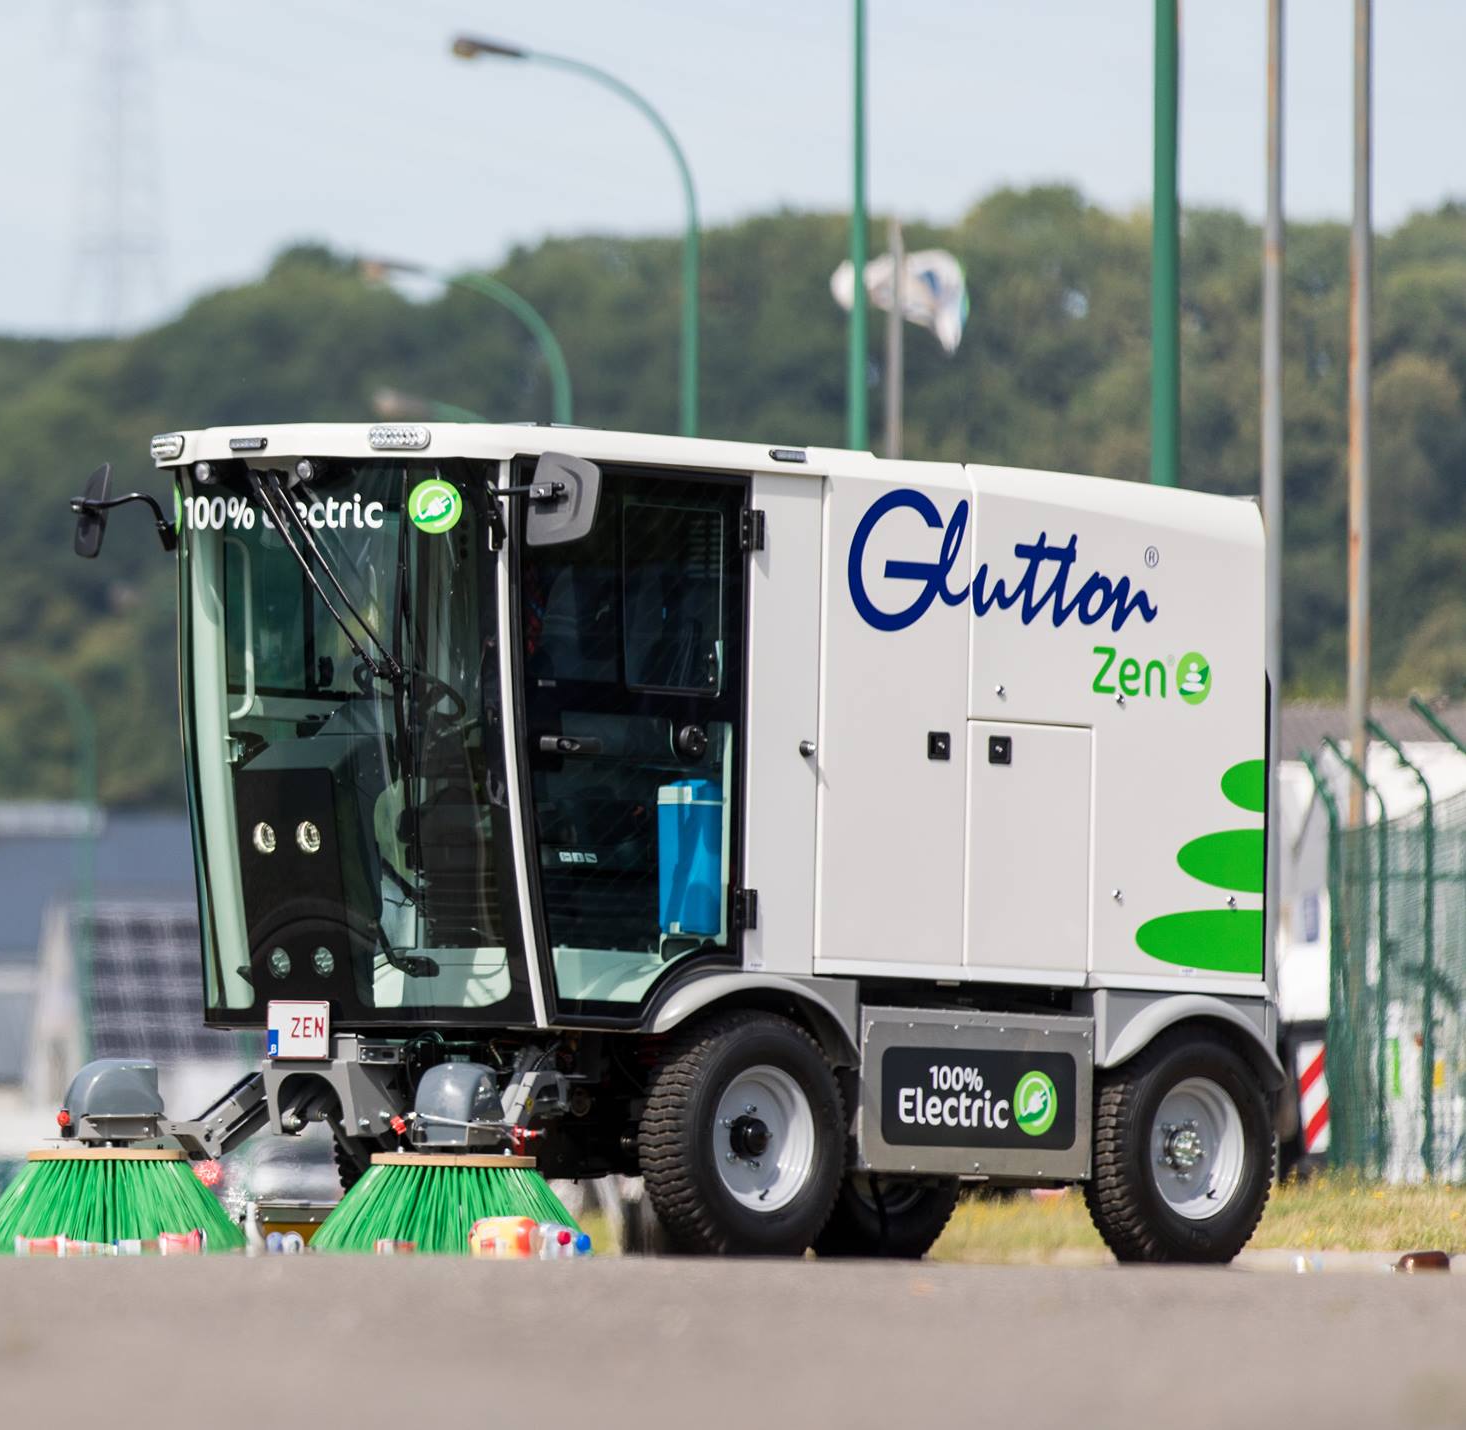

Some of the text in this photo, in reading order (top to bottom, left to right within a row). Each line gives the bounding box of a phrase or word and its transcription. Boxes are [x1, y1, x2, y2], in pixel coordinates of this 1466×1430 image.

[184, 496, 255, 530] 100%
[847, 488, 1158, 632] Glutton
[1092, 646, 1166, 699] Zen
[291, 1016, 325, 1038] ZEN
[929, 1065, 984, 1092] 100%
[898, 1086, 1010, 1129] Electric
